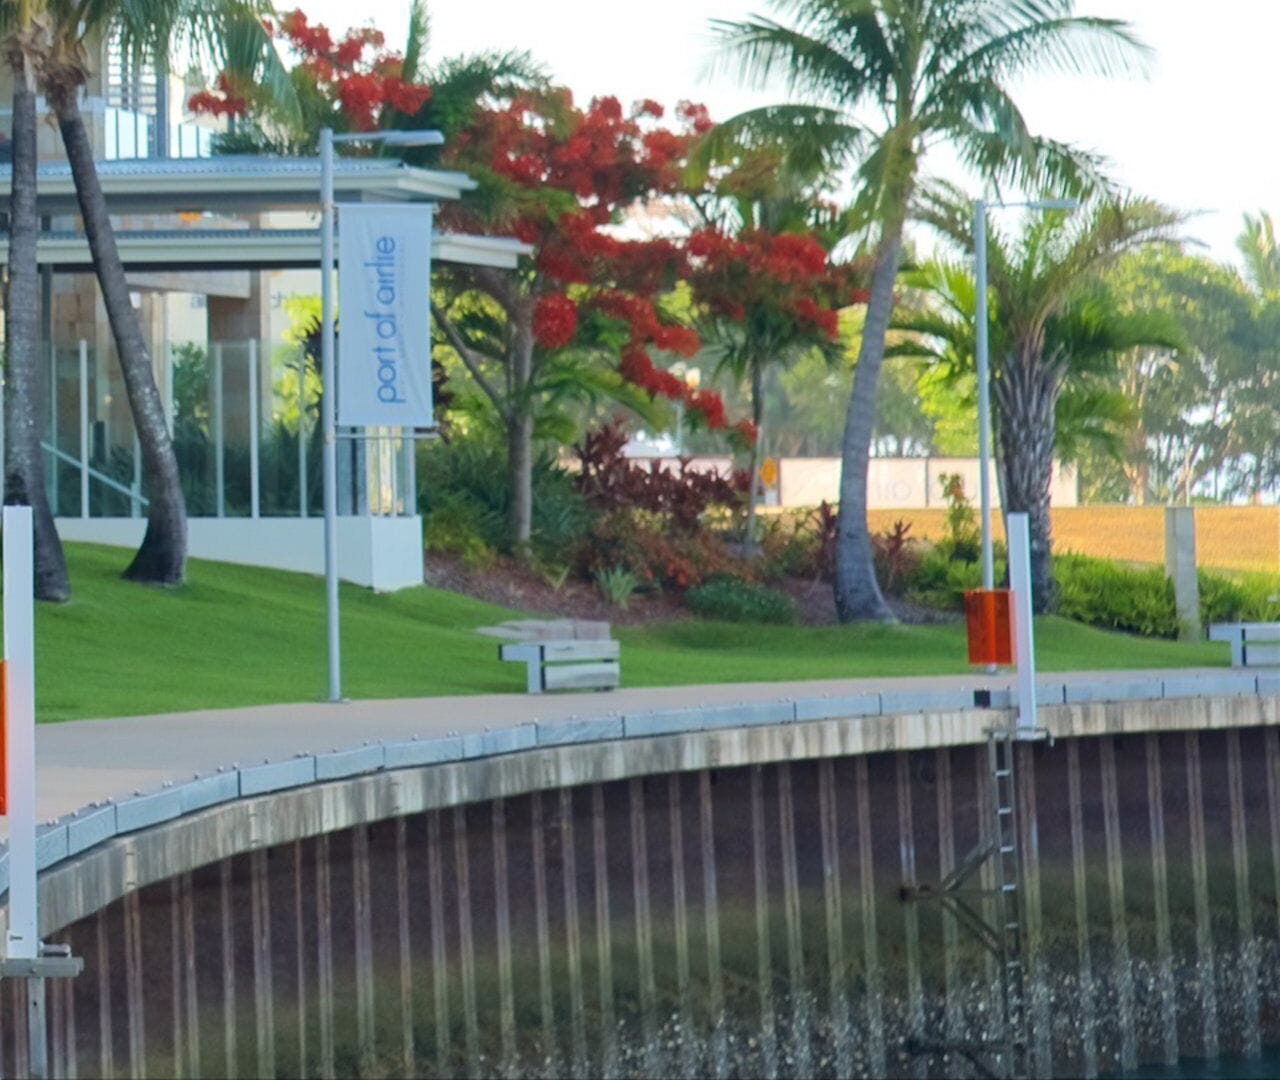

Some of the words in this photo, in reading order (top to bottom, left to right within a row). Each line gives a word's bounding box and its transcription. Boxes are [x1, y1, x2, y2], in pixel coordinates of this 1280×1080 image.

[363, 236, 397, 306] airlie
[363, 311, 397, 340] of
[372, 345, 406, 405] port
